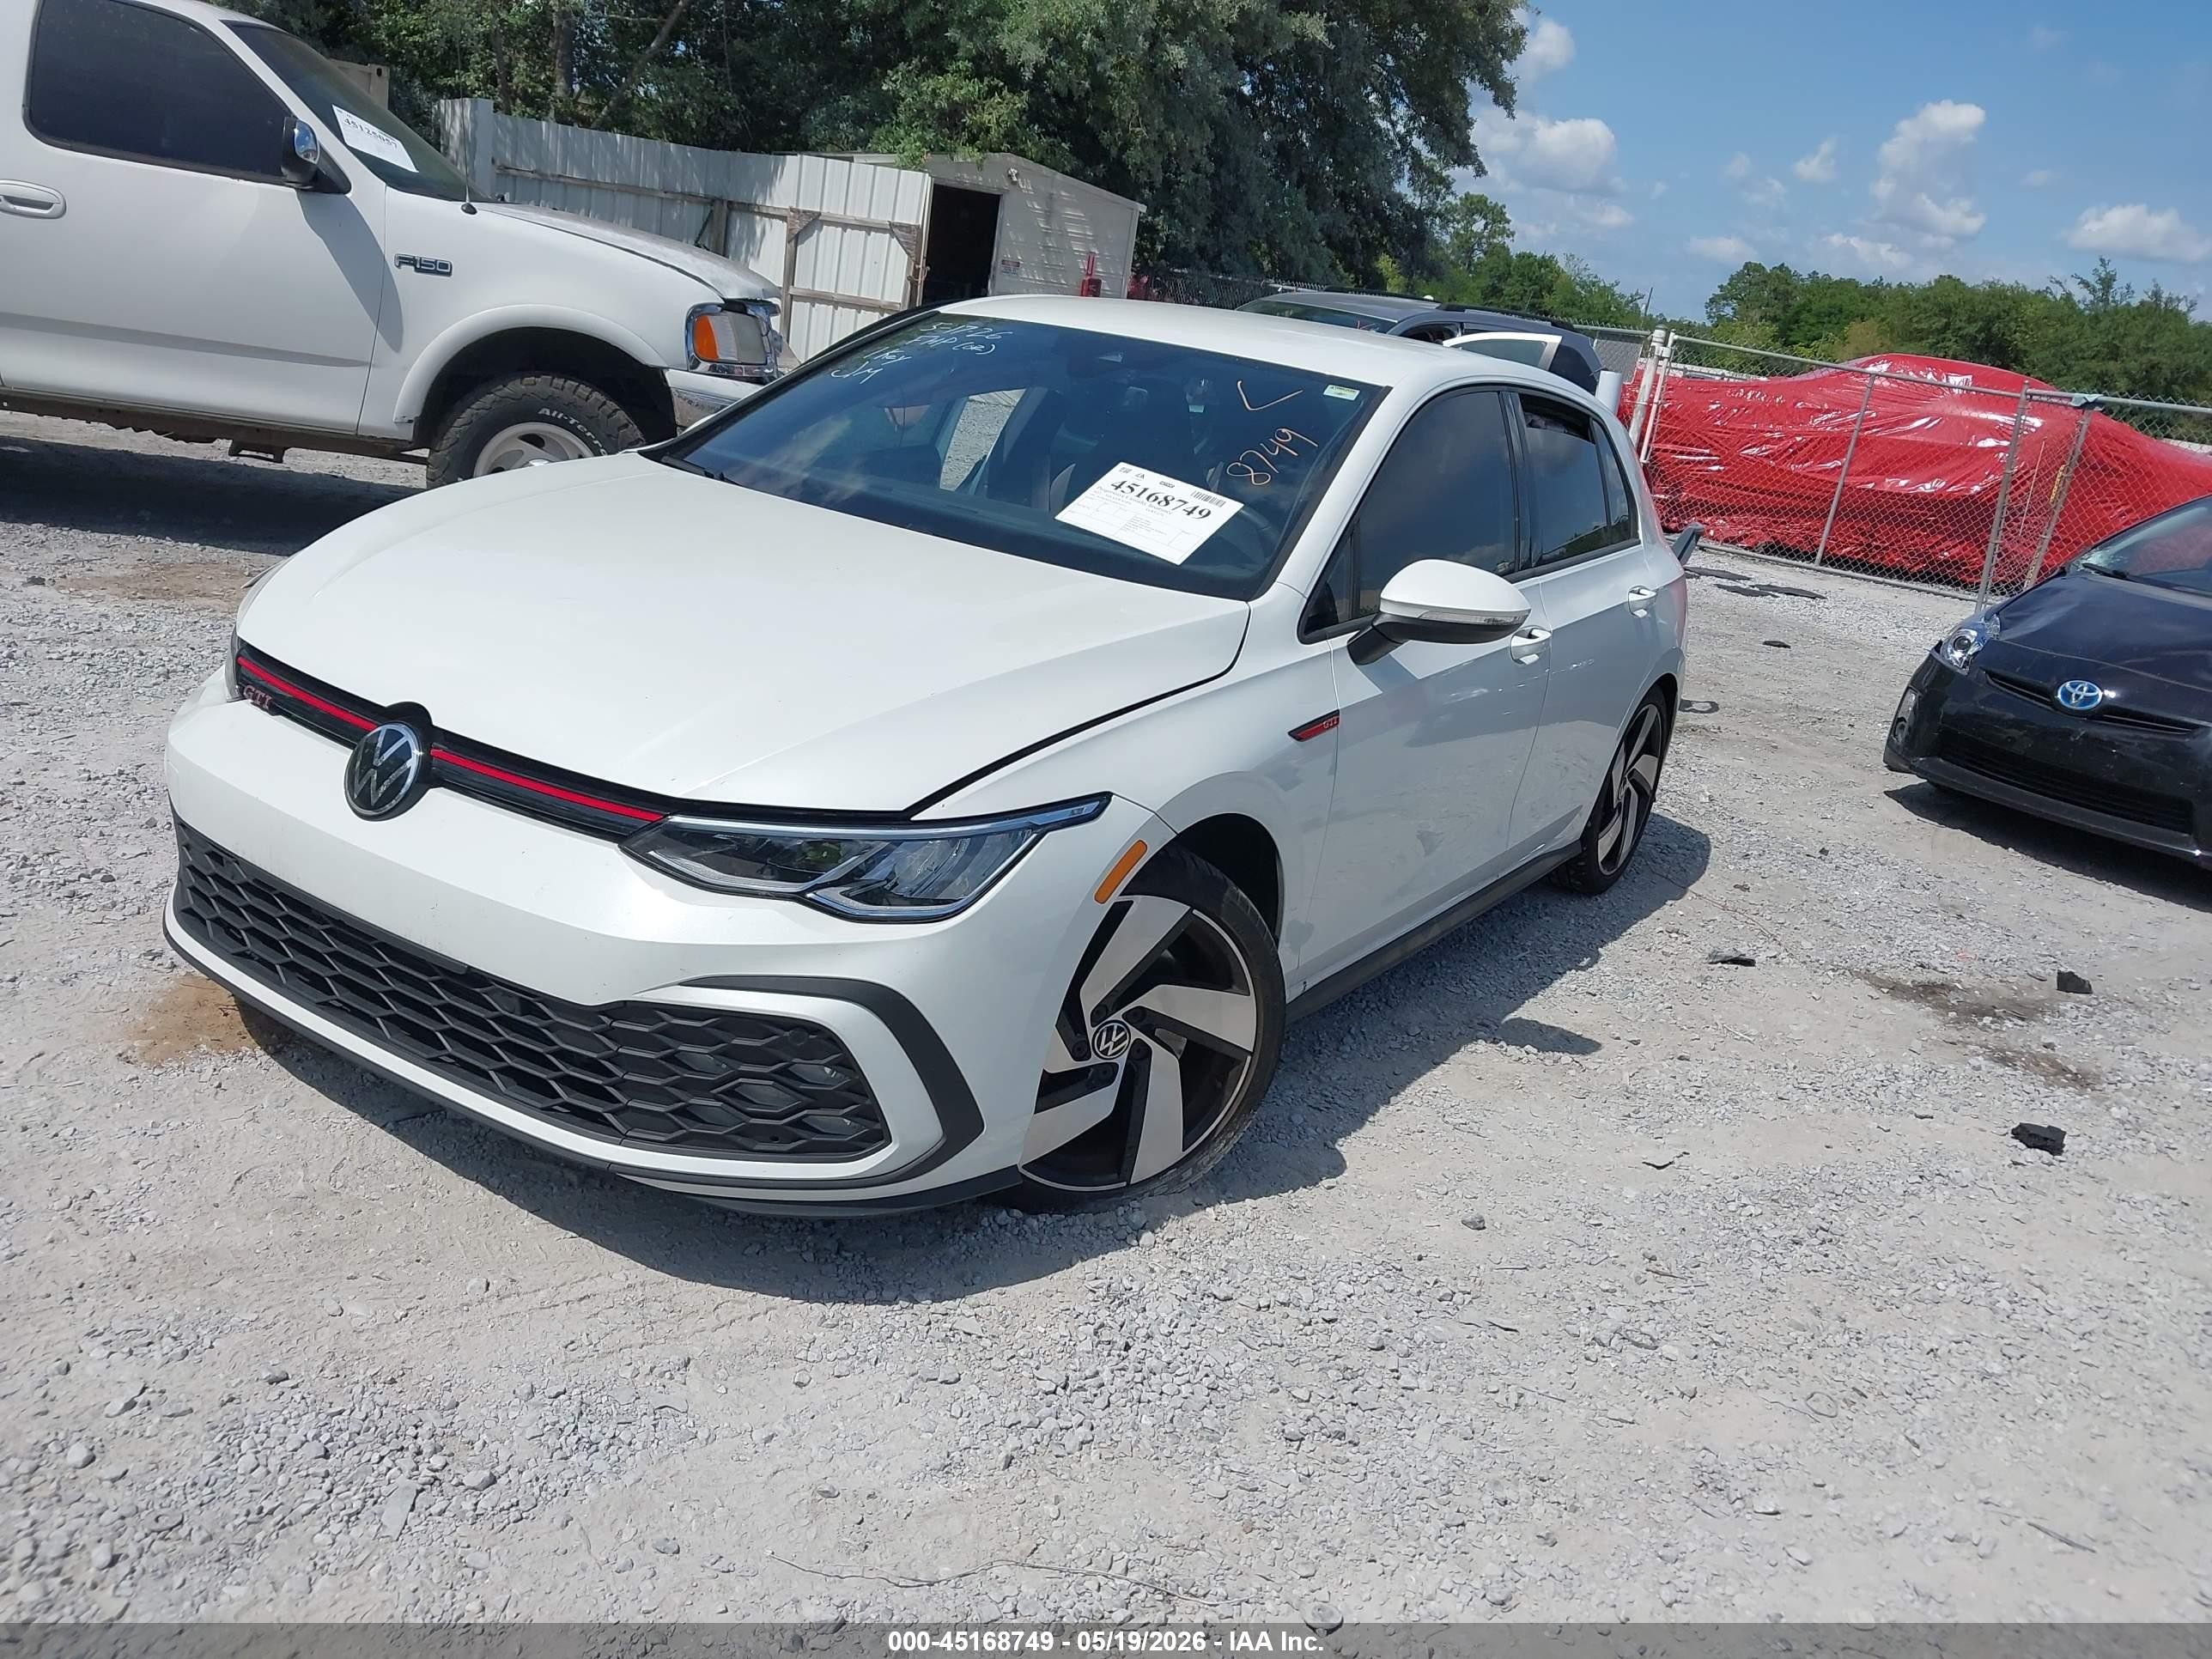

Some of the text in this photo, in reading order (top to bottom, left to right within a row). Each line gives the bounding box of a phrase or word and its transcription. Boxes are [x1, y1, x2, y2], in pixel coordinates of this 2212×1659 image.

[394, 253, 453, 276] F-150
[538, 407, 609, 457] All-Terra
[1226, 428, 1319, 486] 8749
[1110, 479, 1212, 520] 45168749
[243, 684, 273, 710] GTI
[1322, 715, 1340, 729] GTI
